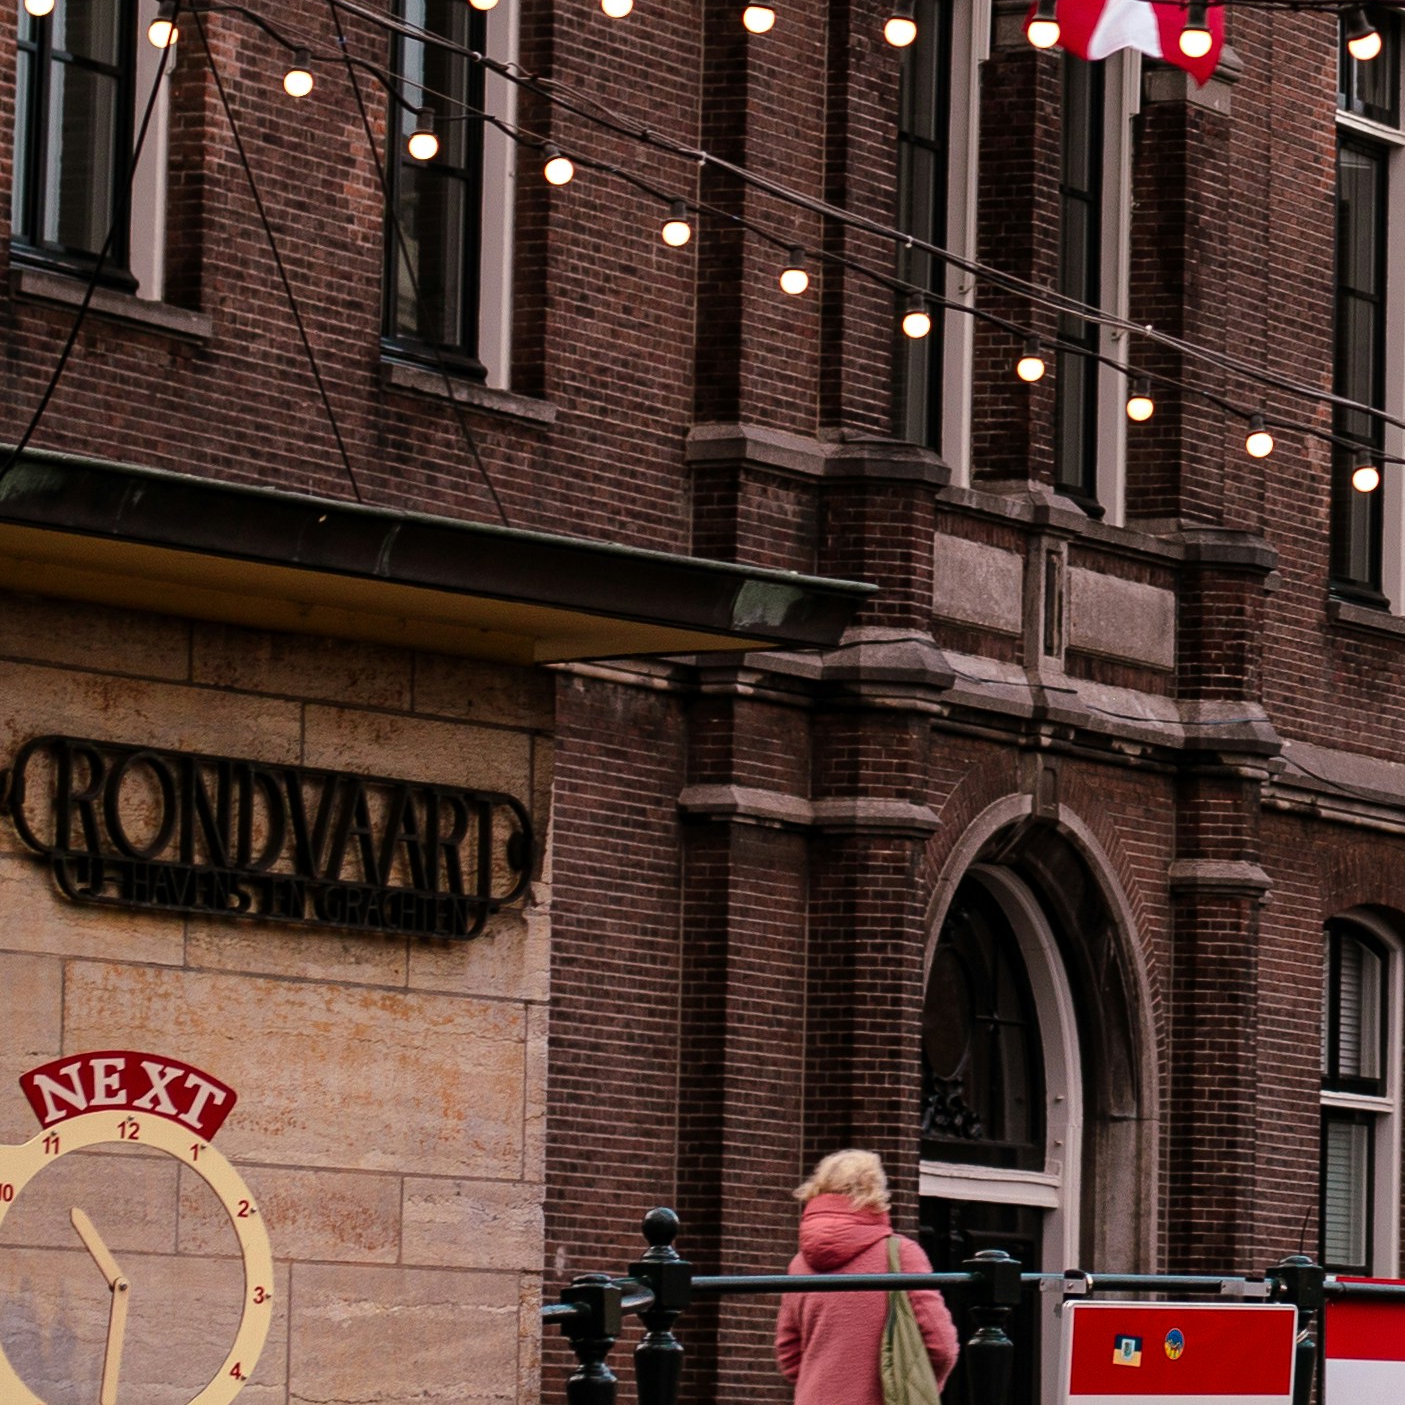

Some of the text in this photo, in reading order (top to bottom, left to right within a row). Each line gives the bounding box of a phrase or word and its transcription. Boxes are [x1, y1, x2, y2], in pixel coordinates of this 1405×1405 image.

[52, 738, 503, 903] RONDVAART
[320, 884, 470, 939] GRACHTEN
[33, 1057, 227, 1130] NEXT
[117, 1121, 141, 1140] 12
[42, 1136, 62, 1155] 11
[190, 1143, 201, 1161] 1
[237, 1199, 250, 1218] 2
[252, 1286, 265, 1305] 3
[229, 1362, 242, 1381] 4
